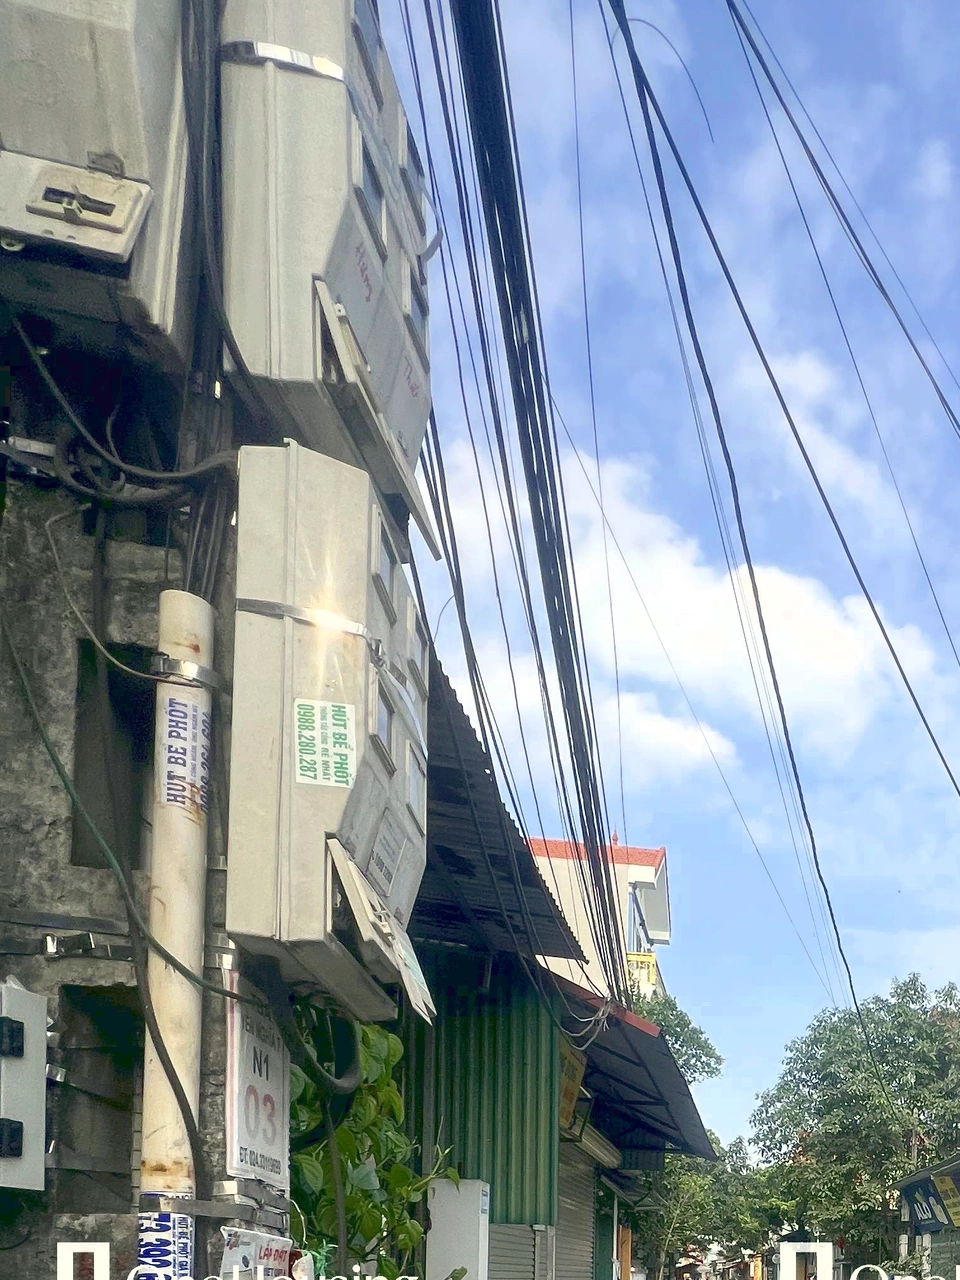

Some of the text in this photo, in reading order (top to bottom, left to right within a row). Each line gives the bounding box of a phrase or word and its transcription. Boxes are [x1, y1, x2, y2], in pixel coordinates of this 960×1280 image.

[297, 703, 318, 781] 0988.280.287
[331, 704, 355, 787] HÚT BỂ PHỐT
[163, 771, 187, 805] HÚT
[252, 1045, 269, 1081] N1
[244, 1084, 277, 1147] 03
